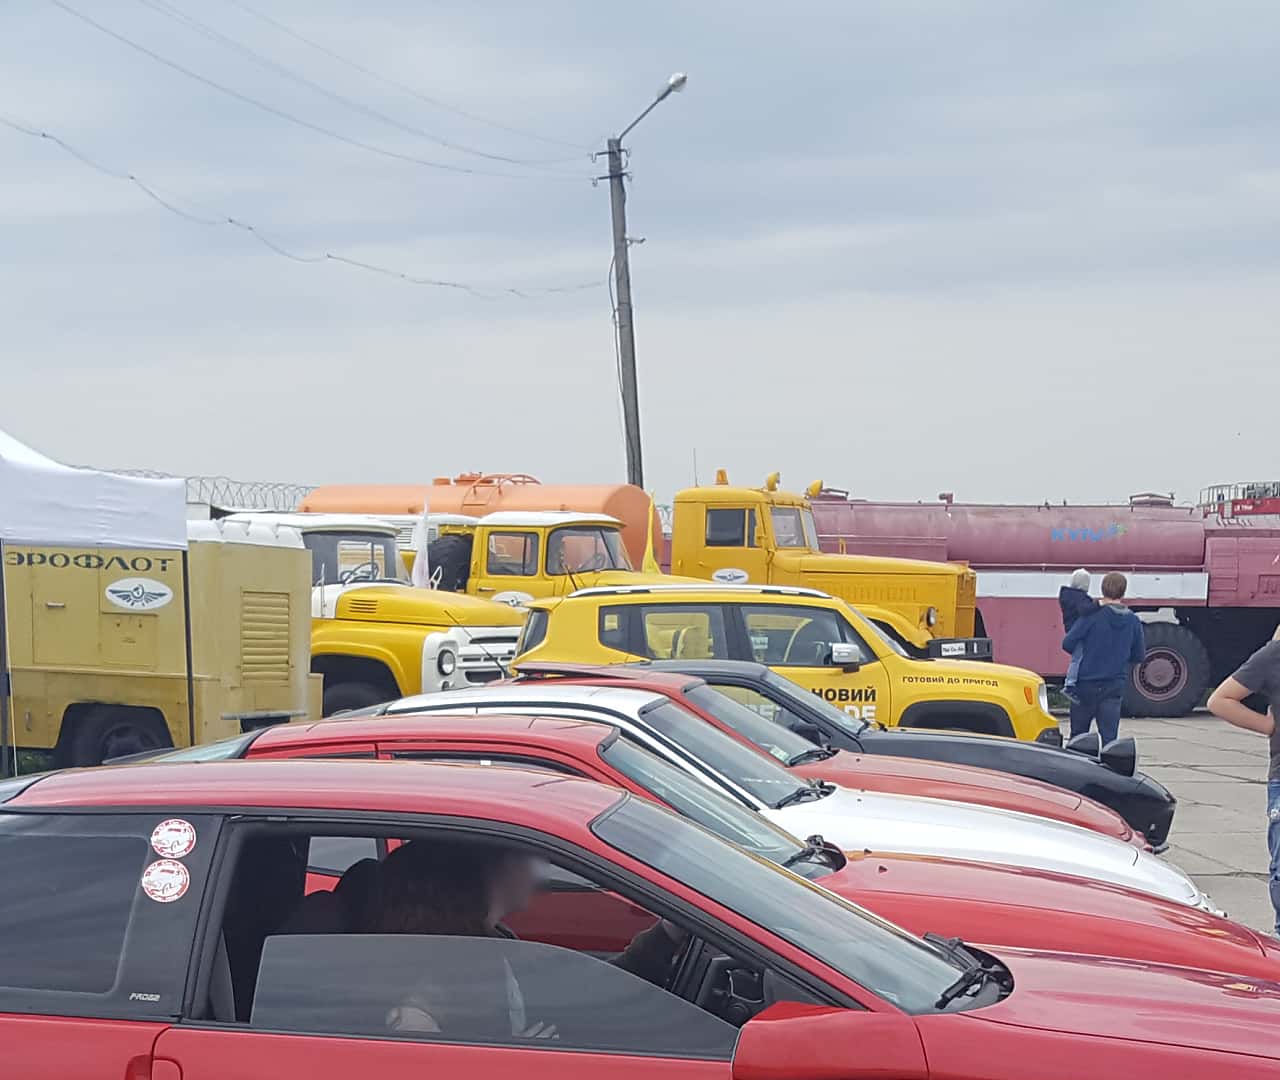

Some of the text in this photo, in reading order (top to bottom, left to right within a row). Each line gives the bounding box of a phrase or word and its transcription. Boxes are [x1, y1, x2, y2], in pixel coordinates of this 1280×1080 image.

[902, 675, 999, 687] ГОТОВИЙ ДО ПРИГОД
[811, 686, 876, 702] НОВИЙ
